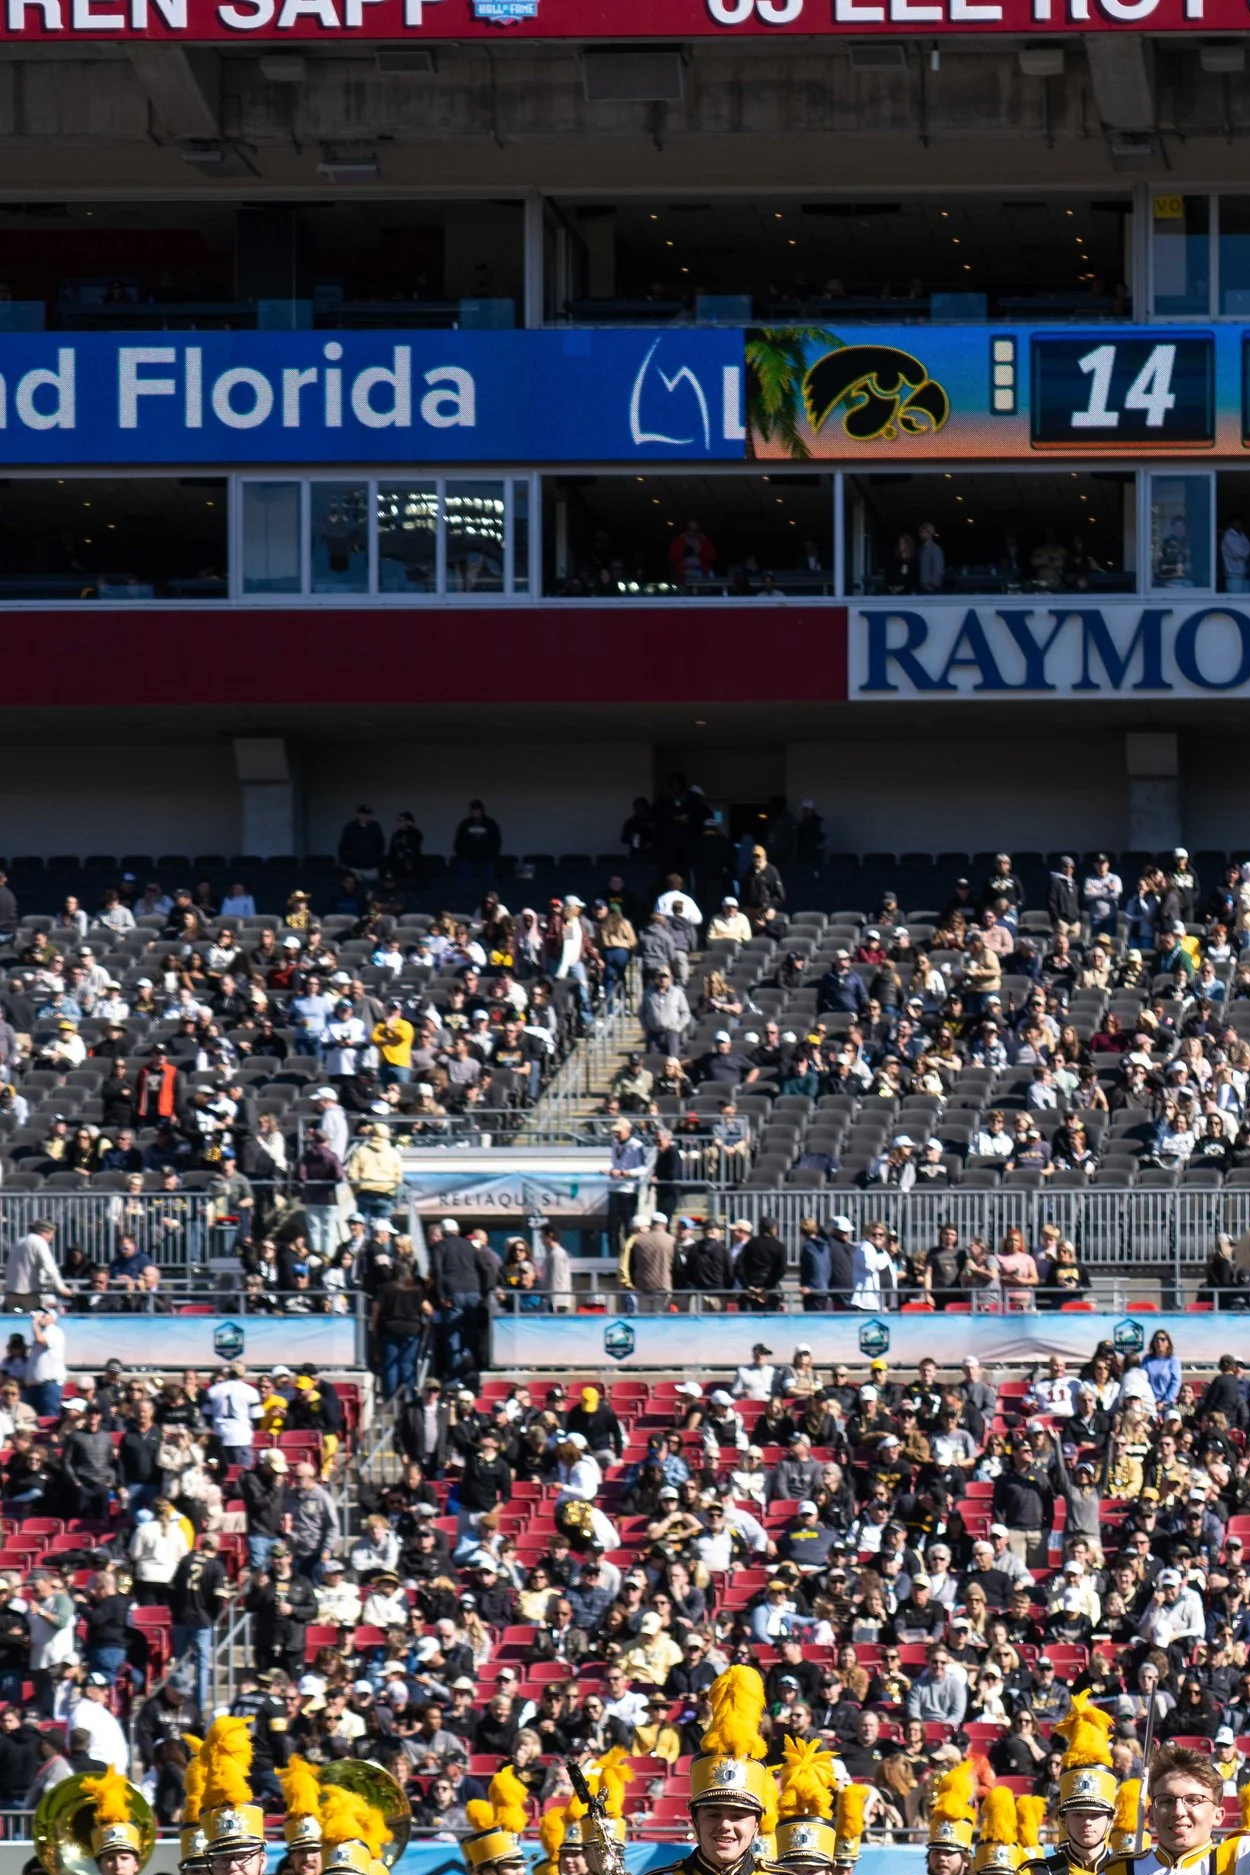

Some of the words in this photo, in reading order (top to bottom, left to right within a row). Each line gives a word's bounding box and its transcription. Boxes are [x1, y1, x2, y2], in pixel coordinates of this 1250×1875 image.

[117, 341, 478, 430] Florida
[1071, 344, 1177, 429] 14
[439, 1191, 561, 1208] RELIAQUST
